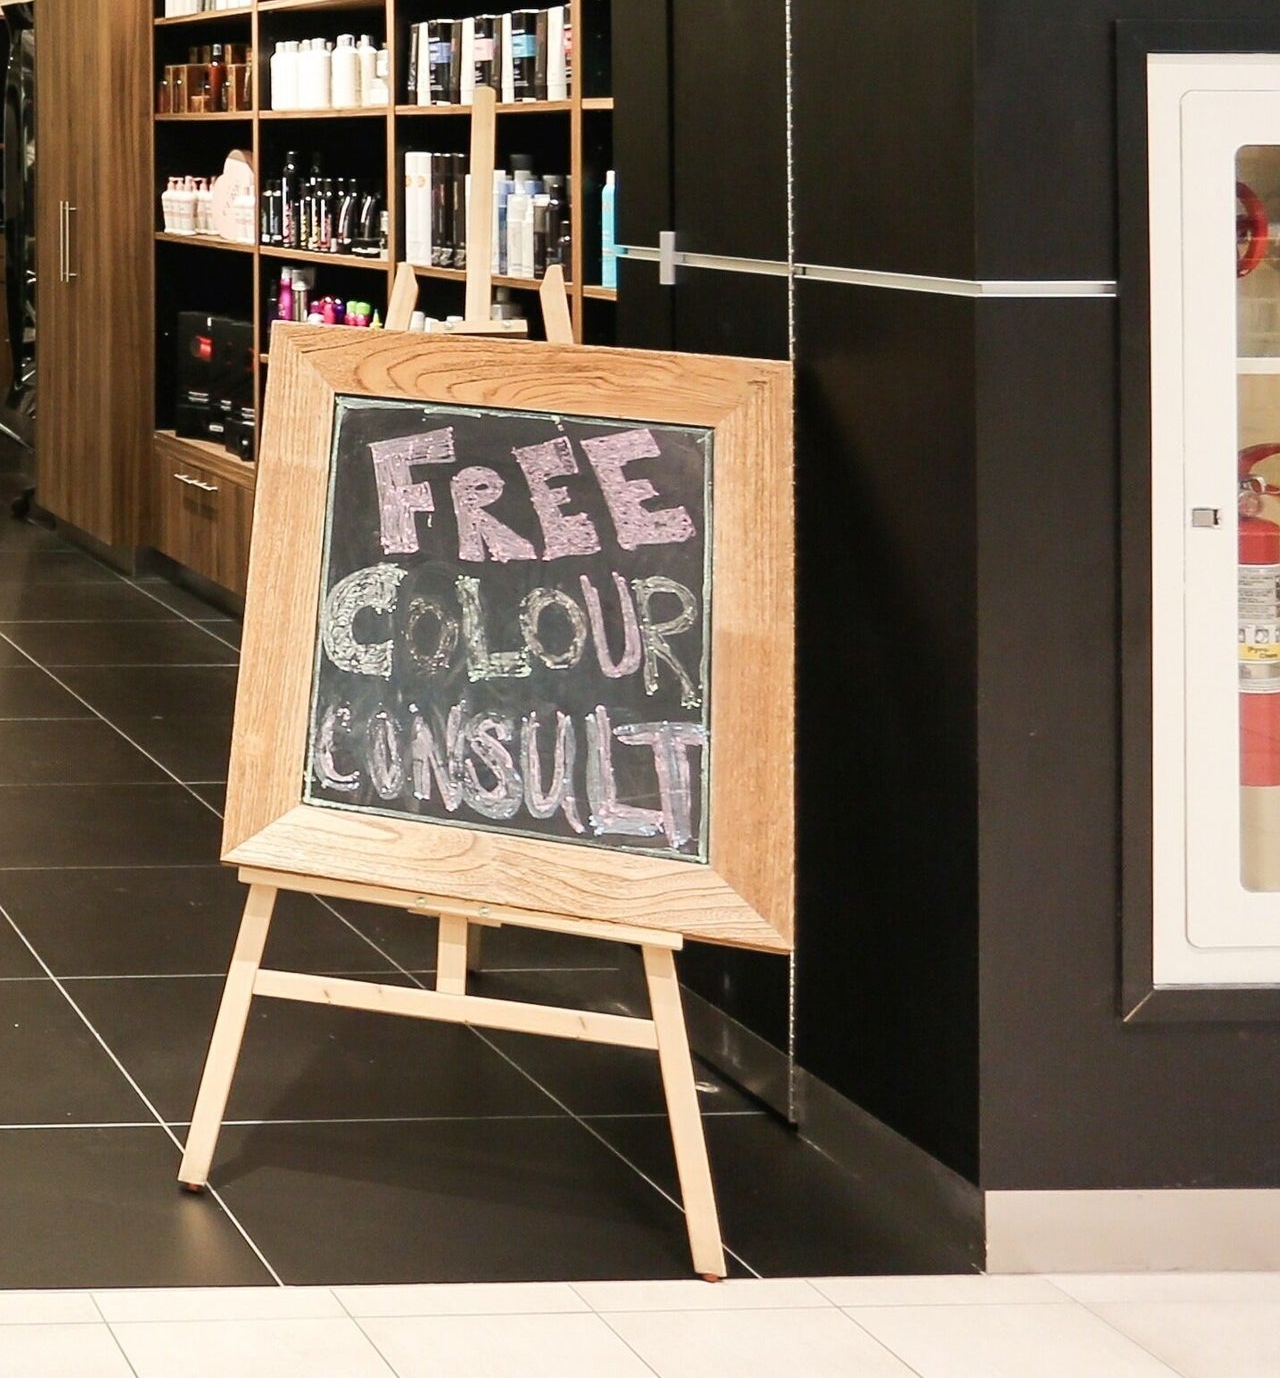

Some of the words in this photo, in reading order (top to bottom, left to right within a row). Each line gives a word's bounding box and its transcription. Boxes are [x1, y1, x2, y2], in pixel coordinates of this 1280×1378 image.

[369, 426, 696, 562] FREE
[321, 562, 702, 708] COLOUR
[313, 698, 709, 848] CONSULT
